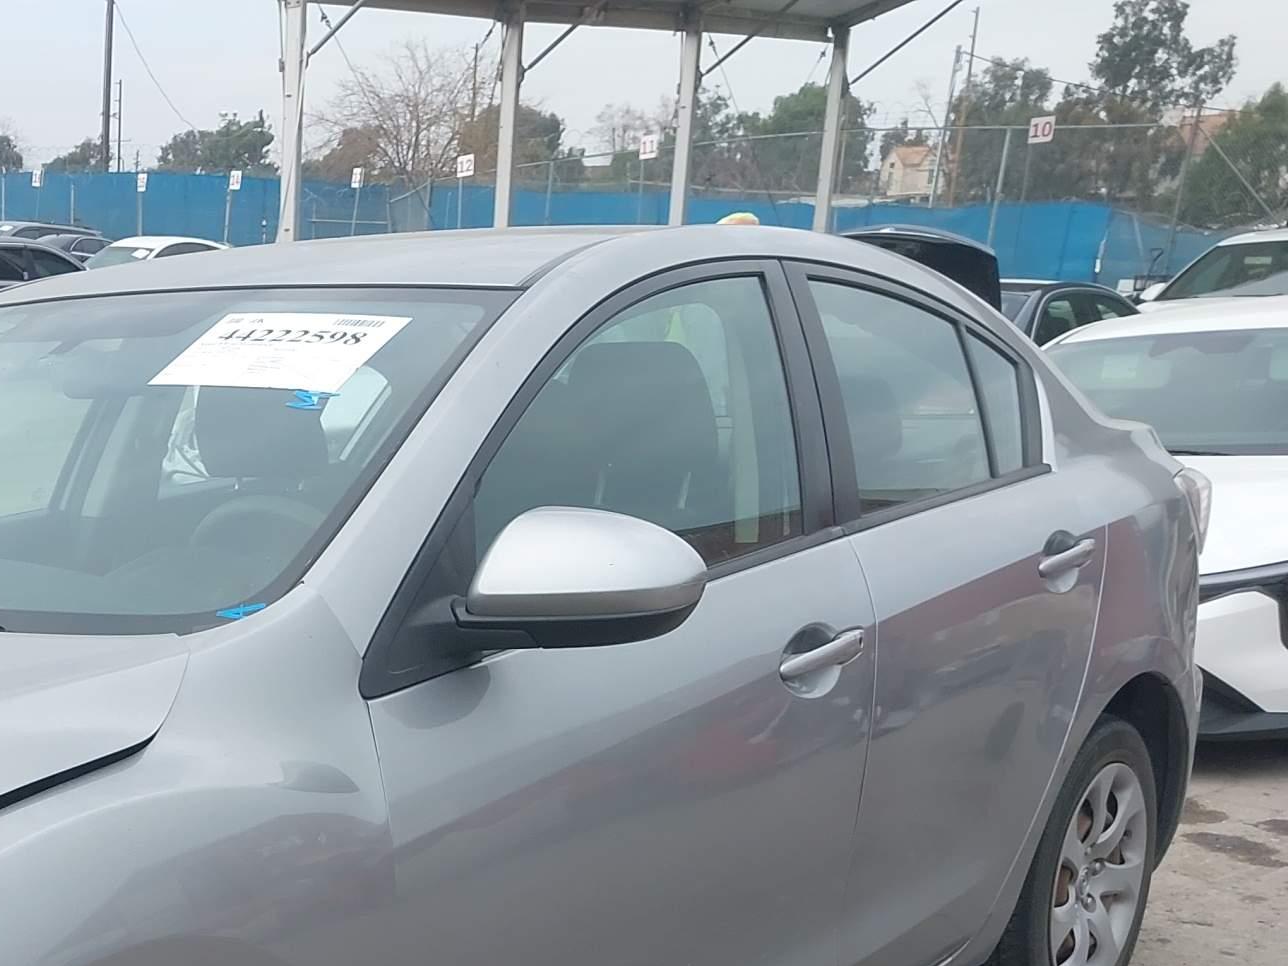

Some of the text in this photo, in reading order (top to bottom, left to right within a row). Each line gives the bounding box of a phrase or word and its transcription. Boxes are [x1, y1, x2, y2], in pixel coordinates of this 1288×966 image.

[1031, 121, 1052, 138] 10
[457, 159, 473, 173] 12
[218, 328, 368, 346] 44222598
